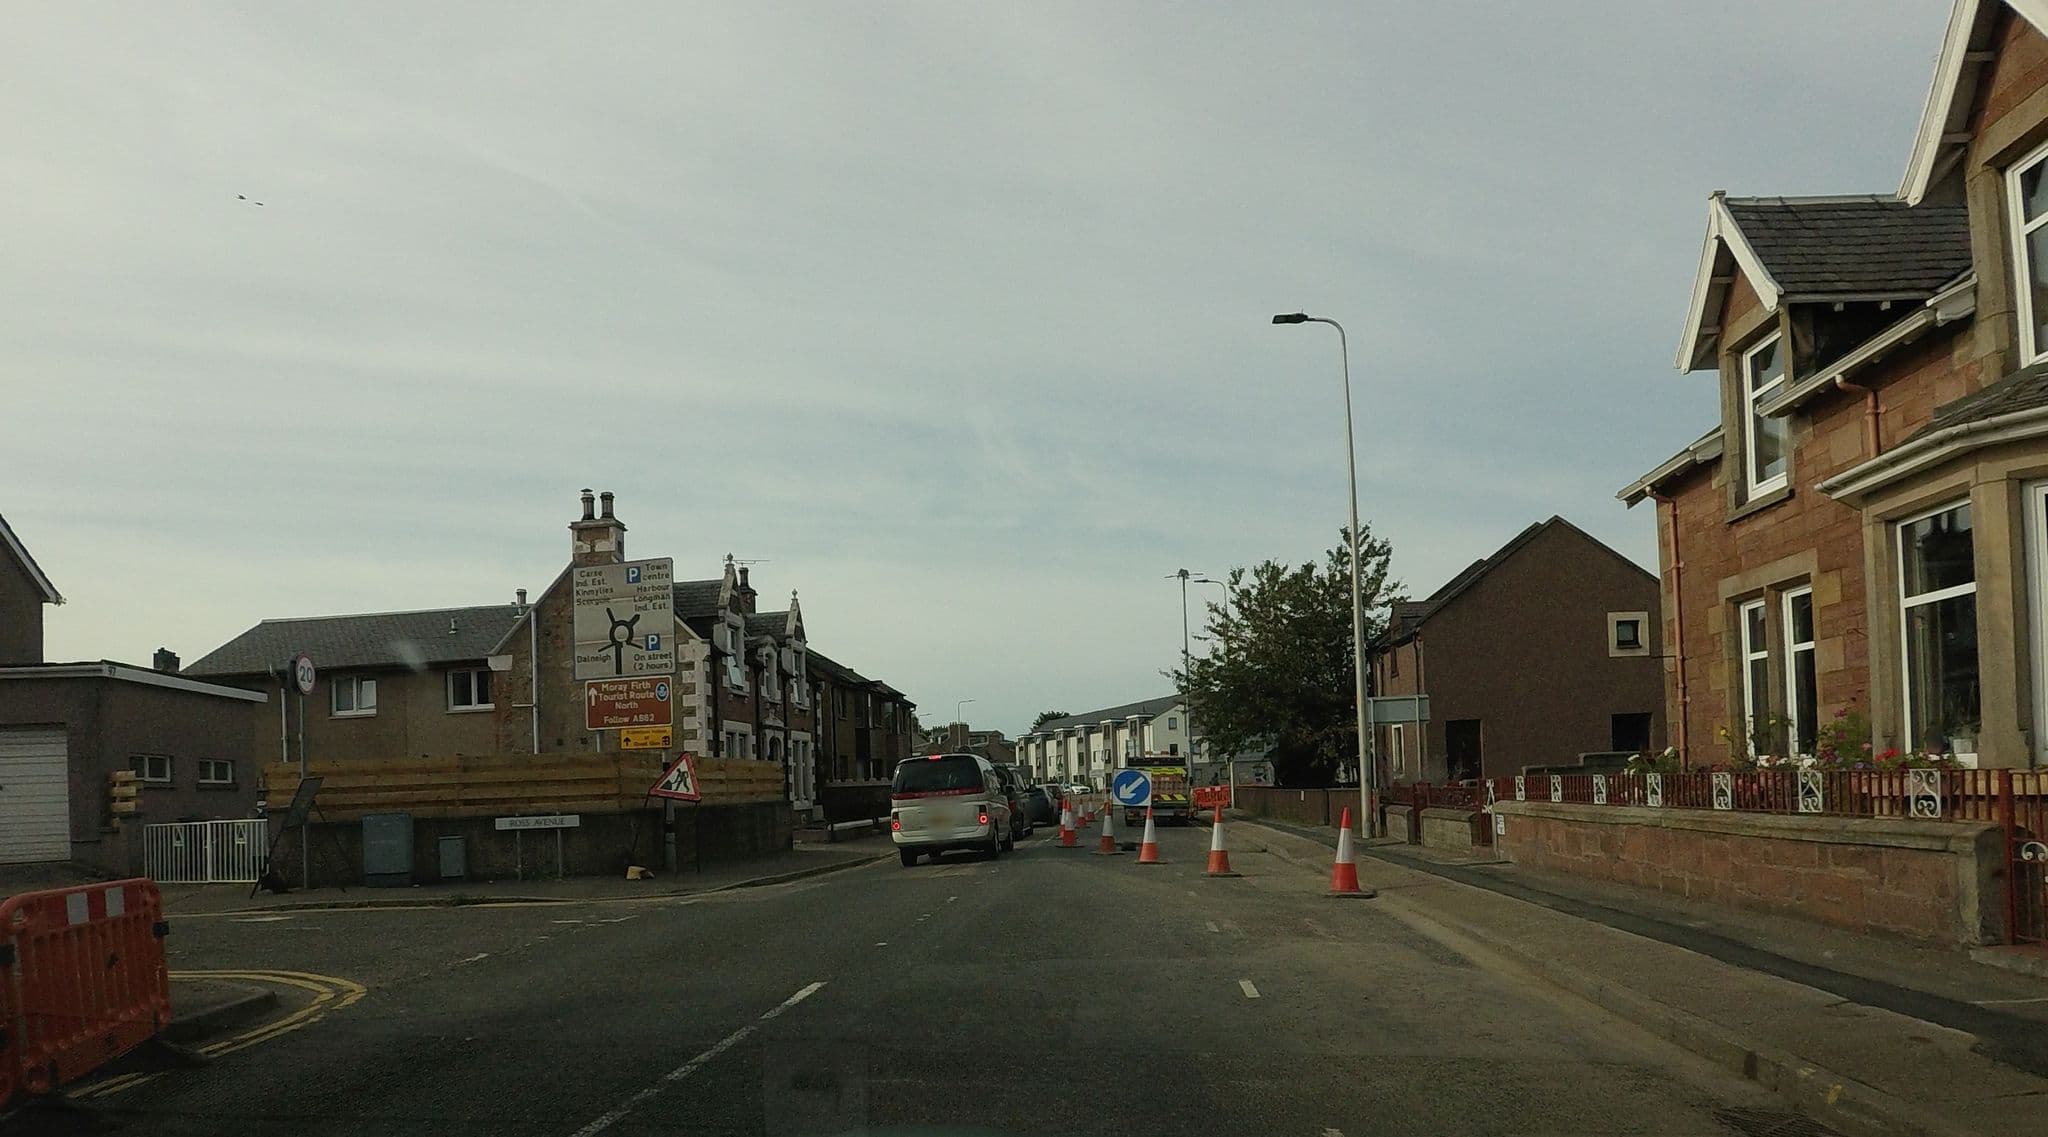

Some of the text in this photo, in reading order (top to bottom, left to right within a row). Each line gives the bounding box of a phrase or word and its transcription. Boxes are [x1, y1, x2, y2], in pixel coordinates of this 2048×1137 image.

[580, 570, 603, 578] Carse
[629, 568, 638, 582] P
[642, 572, 670, 580] centre
[591, 578, 607, 586] Est.
[576, 587, 614, 597] Kinmylies
[636, 584, 670, 593] Harbour
[633, 593, 671, 602] Longman
[634, 602, 669, 612] Ind. Est.
[648, 635, 658, 649] P
[576, 654, 611, 663] Dalneigh
[633, 652, 673, 661] On street
[633, 661, 673, 671] (2 hours)
[300, 665, 312, 683] 20
[601, 681, 651, 692] Moray Firth
[598, 691, 655, 701] Tourist Route
[615, 701, 639, 710] North
[603, 716, 630, 724] Follow
[535, 817, 566, 826] AVENUE
